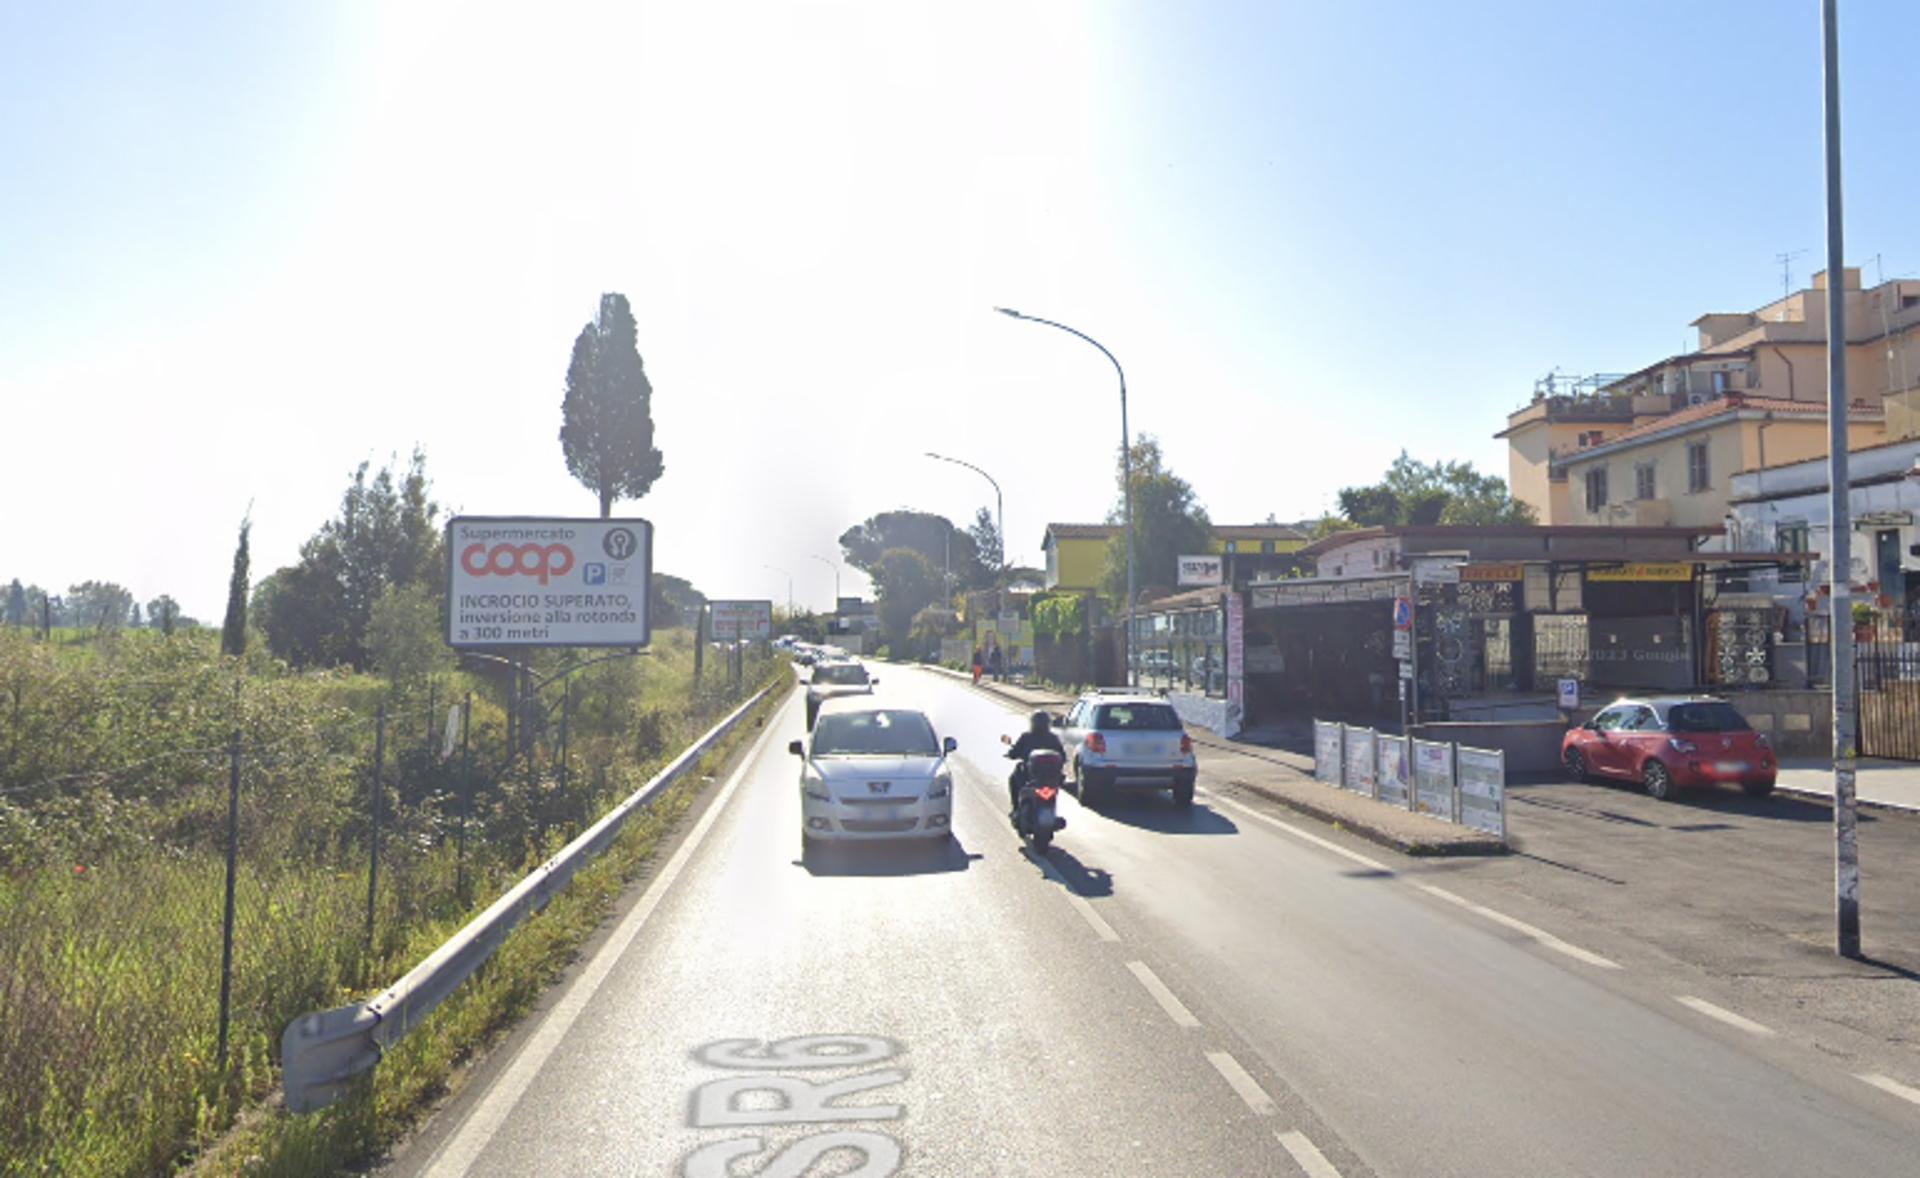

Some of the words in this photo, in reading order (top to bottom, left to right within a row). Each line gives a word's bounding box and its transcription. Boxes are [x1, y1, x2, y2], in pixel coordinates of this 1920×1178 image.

[460, 527, 575, 540] Supermercato
[461, 542, 575, 586] coop
[460, 595, 539, 609] INCROCIO
[544, 595, 632, 609] SUPERATO,
[459, 611, 541, 624] inversione
[544, 610, 571, 624] alla
[576, 610, 636, 624] rotonda
[459, 629, 469, 639] a
[475, 627, 502, 640] 300
[507, 628, 549, 640] metri
[676, 1034, 910, 1178] SR6
